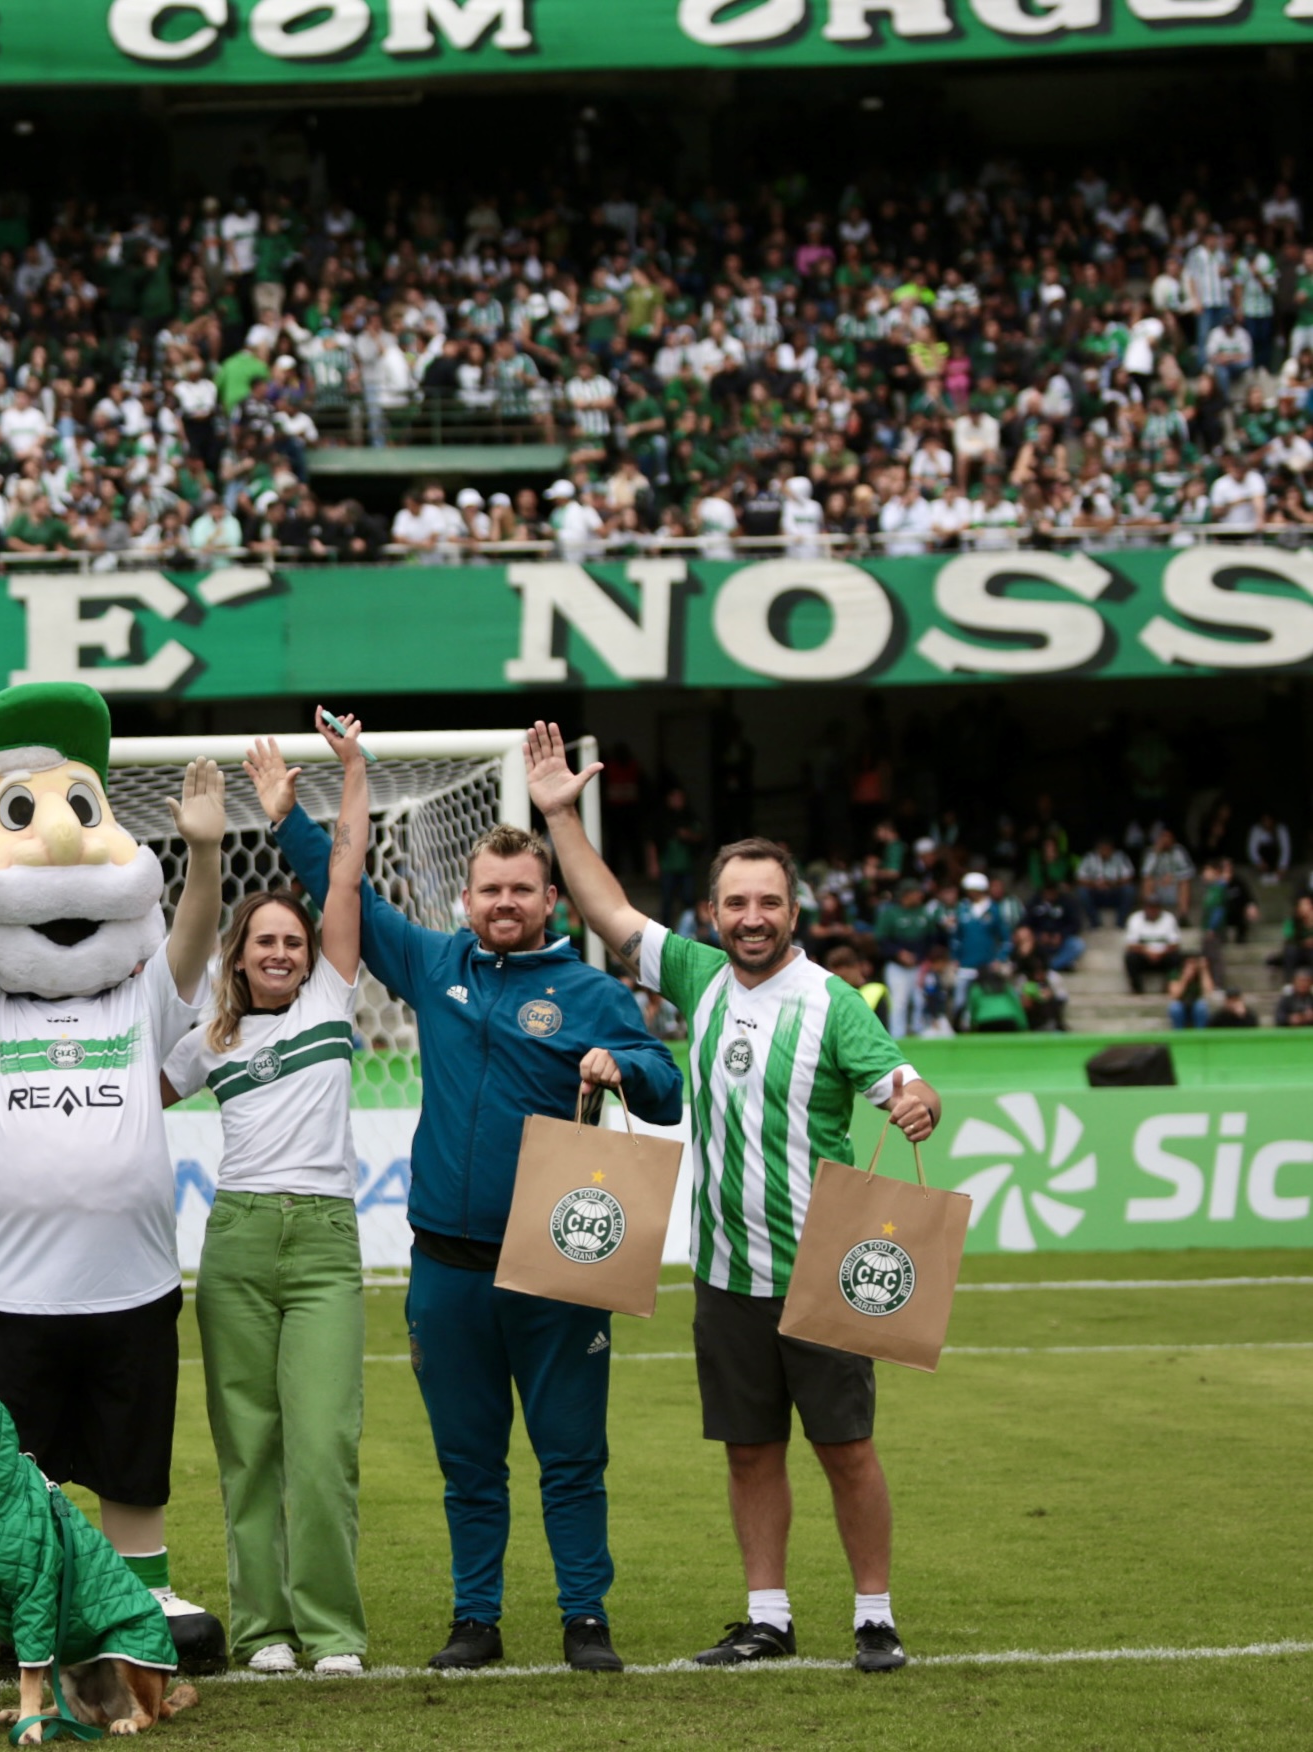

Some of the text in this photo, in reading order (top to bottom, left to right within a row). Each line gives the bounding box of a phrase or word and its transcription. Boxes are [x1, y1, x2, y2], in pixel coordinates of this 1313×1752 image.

[107, 0, 533, 60] COM
[8, 1085, 123, 1117] REALS
[552, 1190, 623, 1243] CORITIBA FOOT BALL CLUB
[567, 1213, 608, 1237] CFC
[842, 1242, 913, 1297] CORITIBA FOOT BALL CLUB
[857, 1265, 898, 1290] CFC
